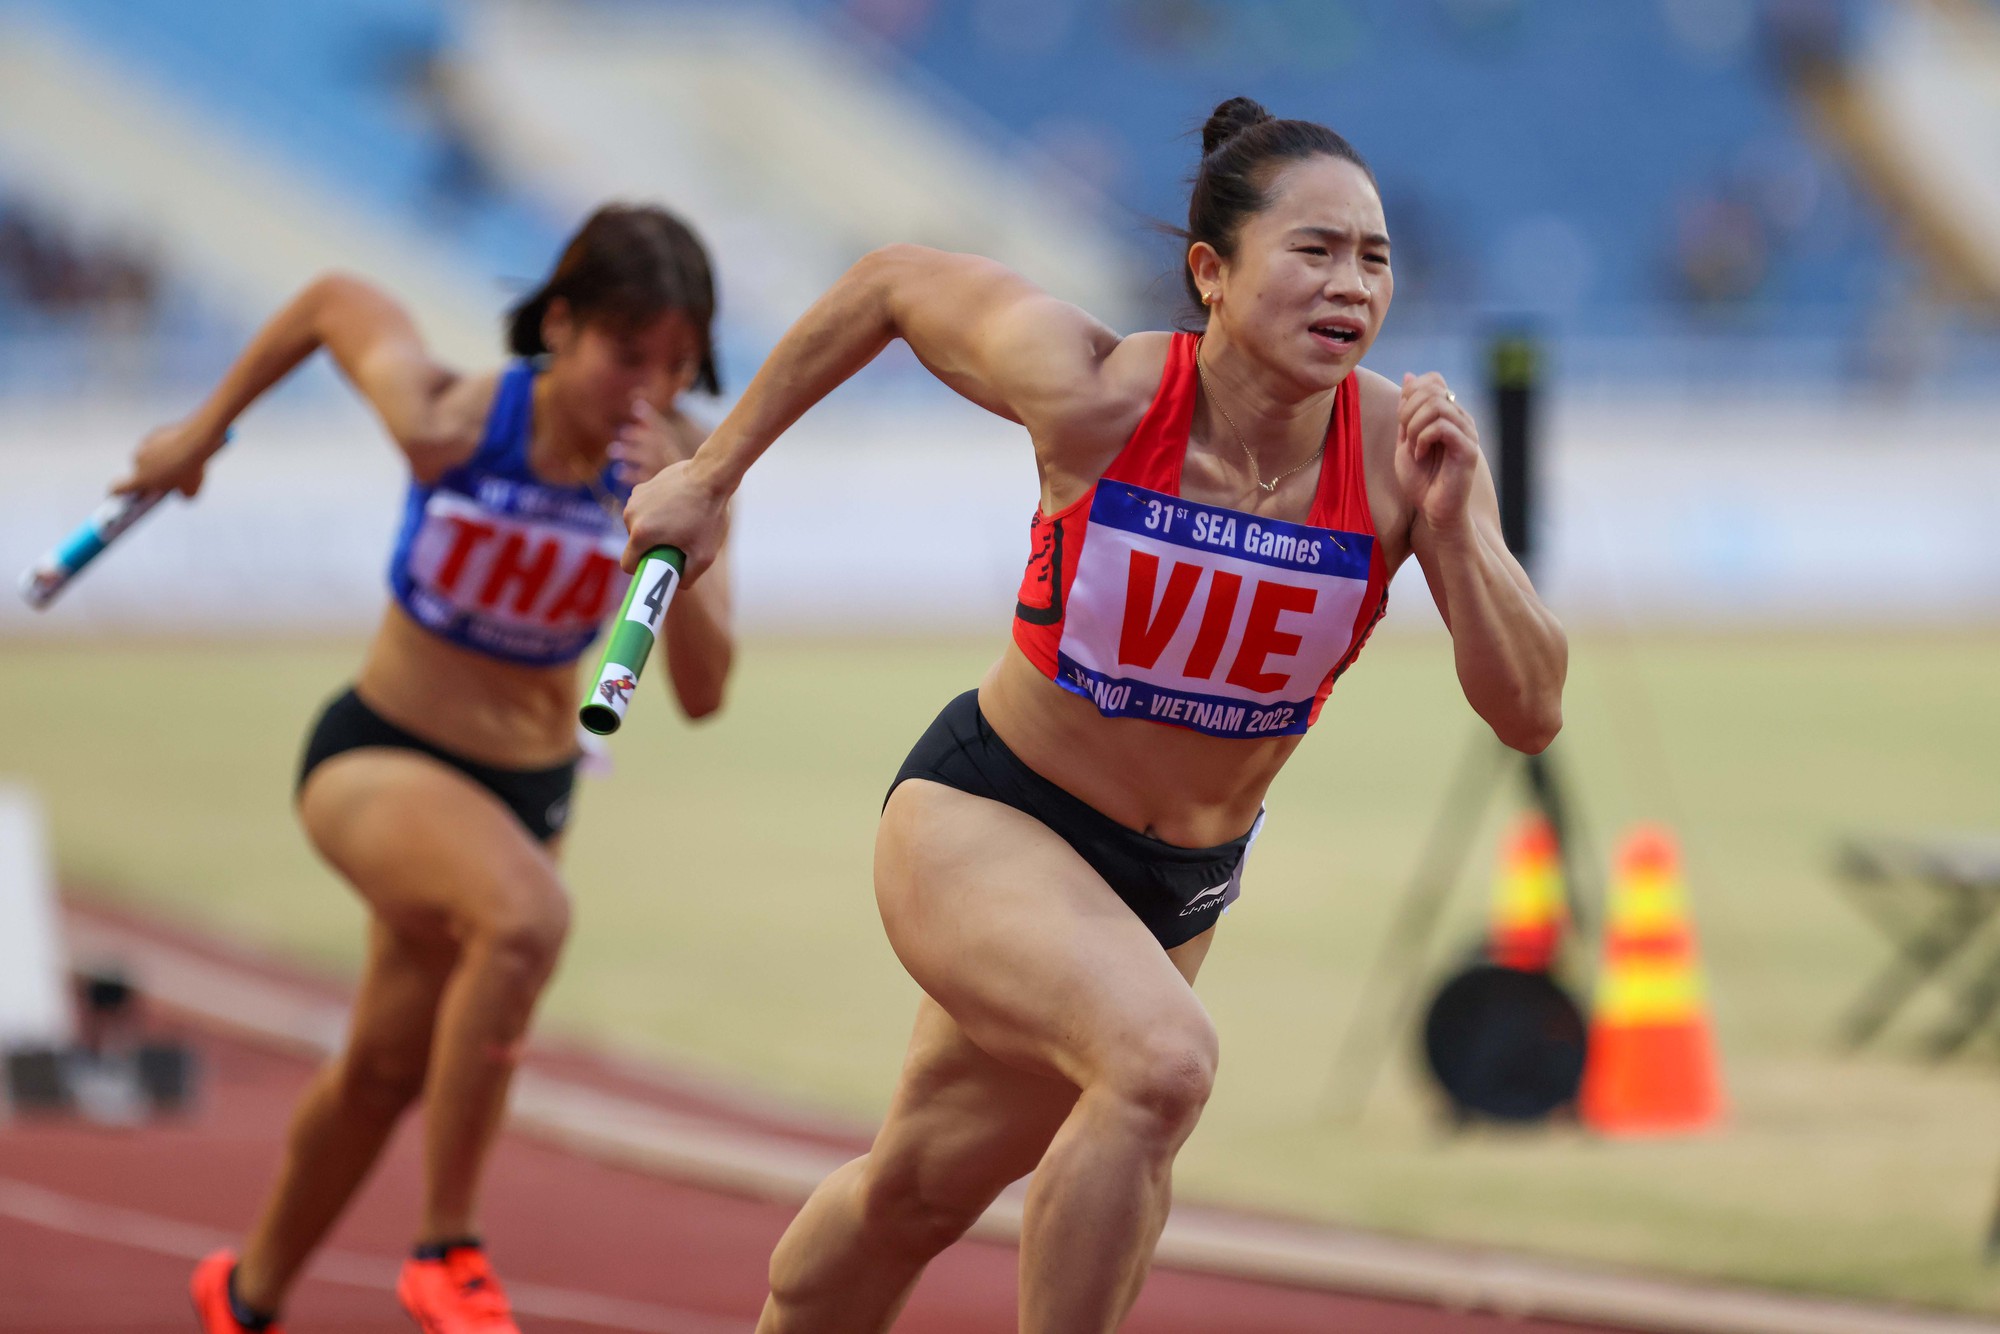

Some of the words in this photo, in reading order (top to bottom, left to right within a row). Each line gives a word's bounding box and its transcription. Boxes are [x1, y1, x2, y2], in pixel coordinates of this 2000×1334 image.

[1192, 511, 1237, 549] SEA
[1244, 523, 1322, 565] Games
[438, 513, 621, 624] THA
[644, 568, 674, 626] 4
[1118, 549, 1318, 694] VIE
[1149, 694, 1245, 732] VIETNAM
[1246, 707, 1293, 733] 2022
